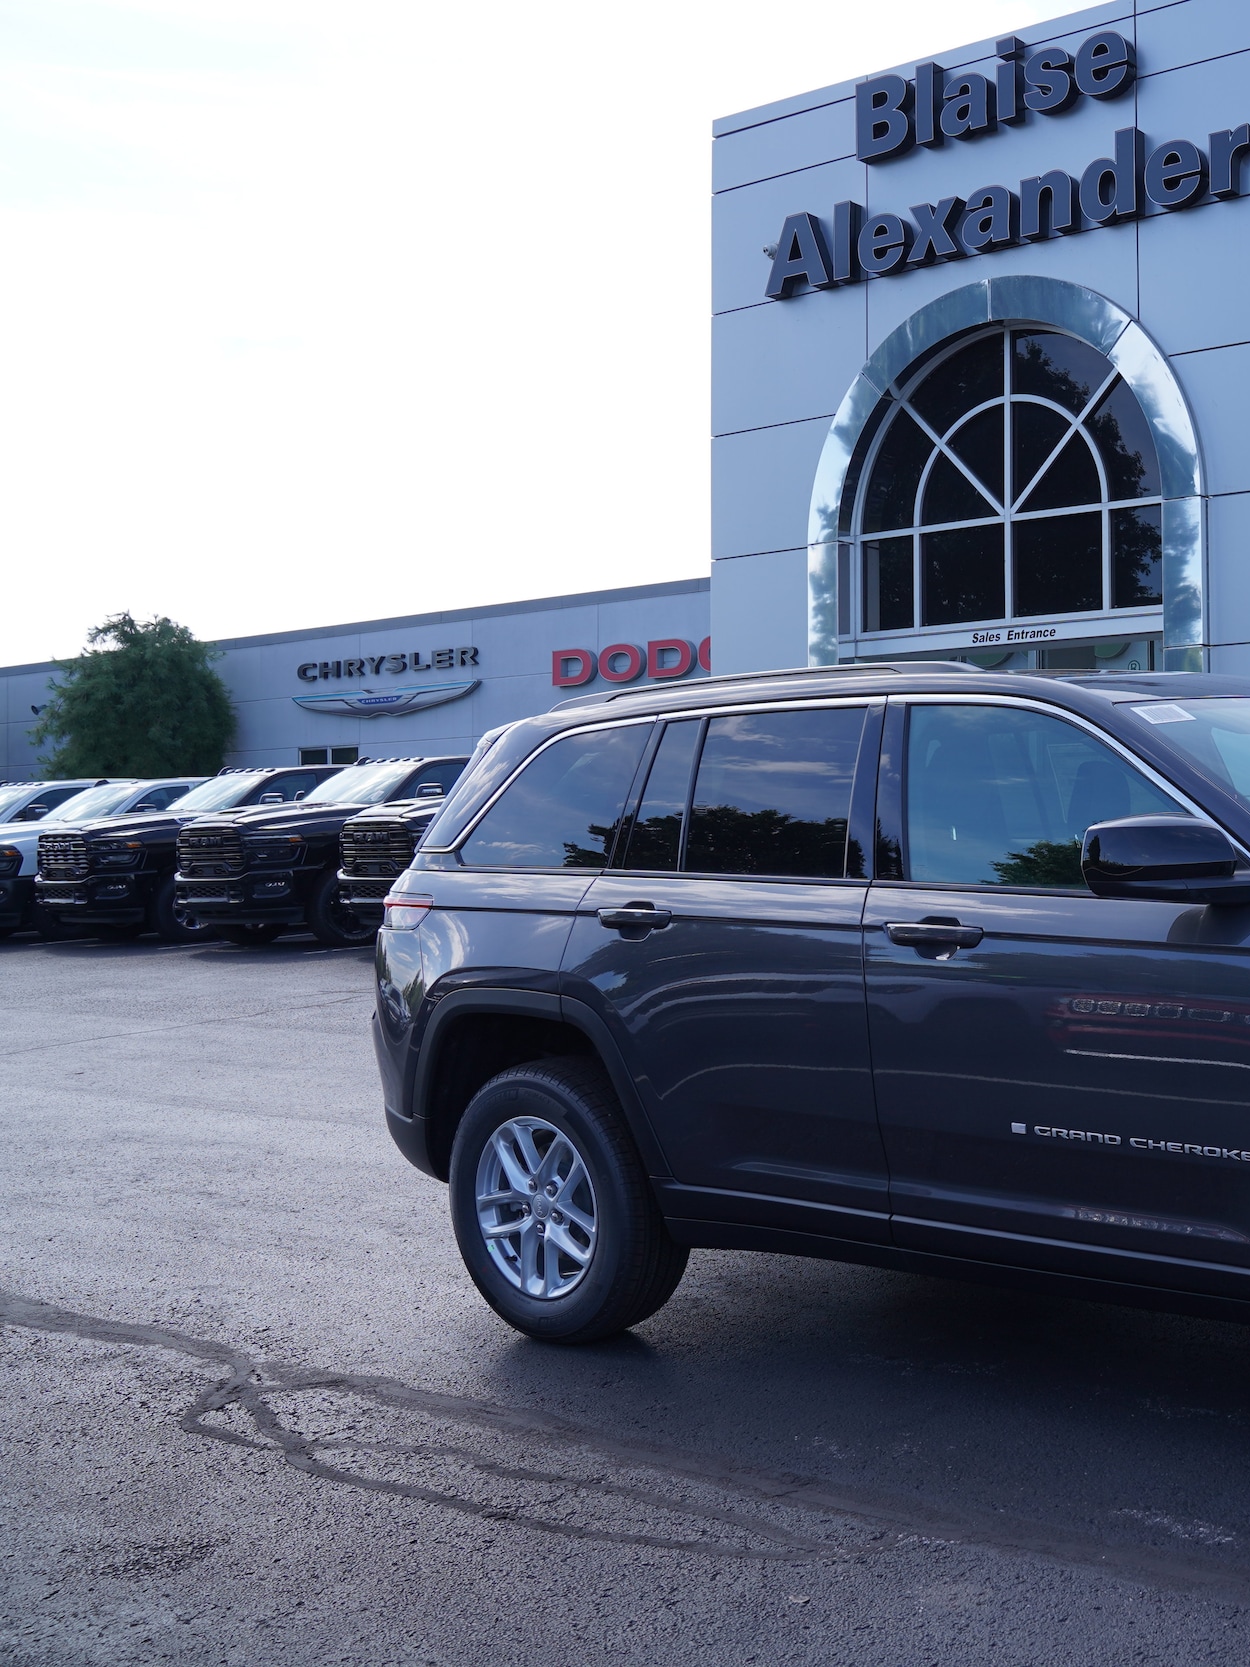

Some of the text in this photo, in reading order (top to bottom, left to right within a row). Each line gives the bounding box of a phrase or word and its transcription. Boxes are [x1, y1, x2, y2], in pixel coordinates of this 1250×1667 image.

[855, 30, 1138, 165] Blaise
[972, 628, 1057, 644] Sales Entrance
[297, 646, 479, 682] CHRYSLER
[552, 635, 711, 688] DOD
[361, 696, 398, 704] CHRYSLER
[1033, 1125, 1122, 1146] GRAND
